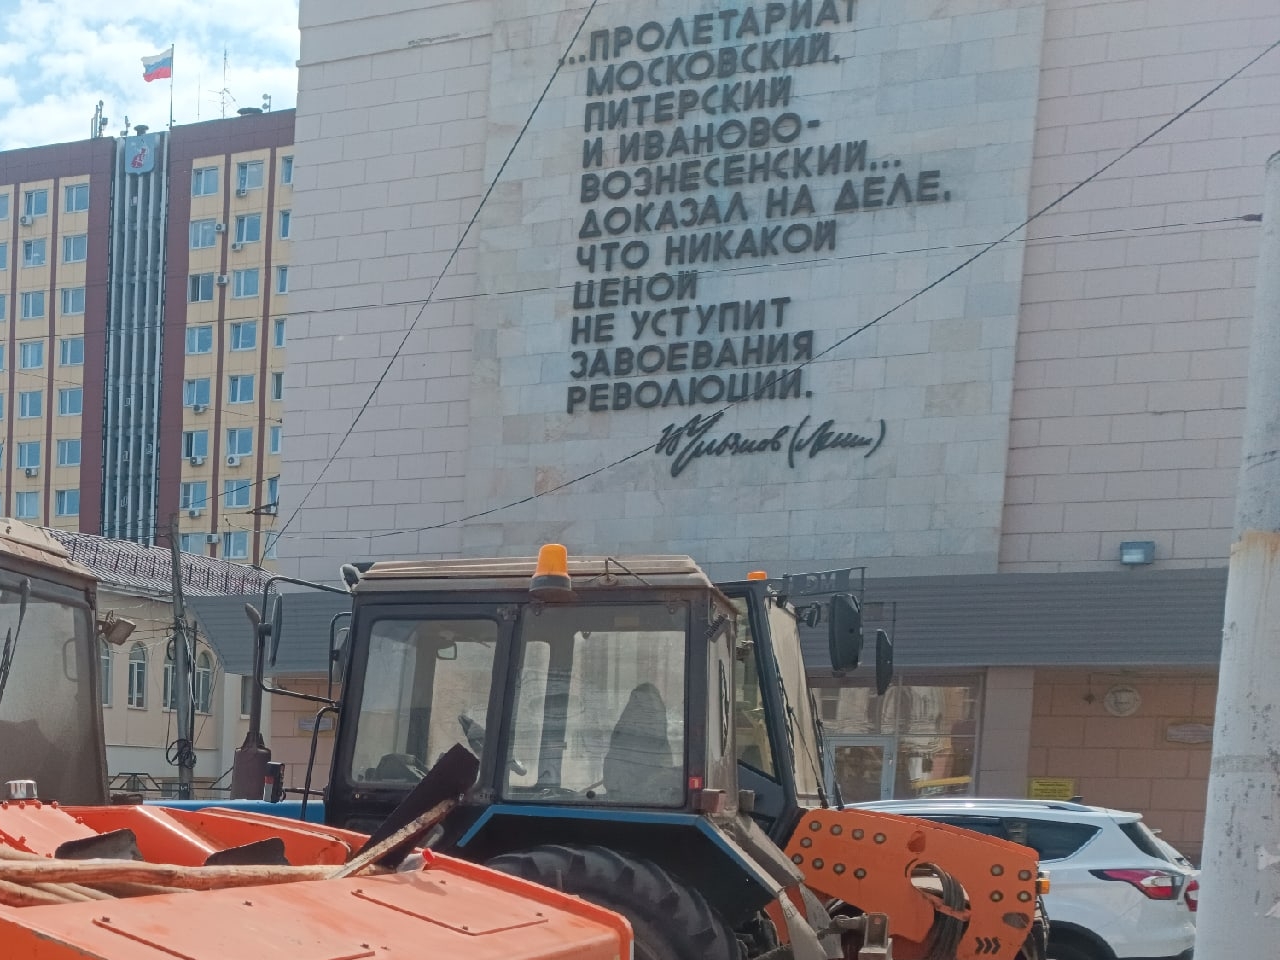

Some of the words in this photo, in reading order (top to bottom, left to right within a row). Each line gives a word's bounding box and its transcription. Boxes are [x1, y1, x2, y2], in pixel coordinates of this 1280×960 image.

[584, 75, 792, 132] ПИТЕРСКИЙ
[582, 136, 604, 169] И
[619, 112, 821, 164] ИВАНОВО-
[578, 191, 749, 240] ДОКАЗАЛ
[766, 184, 816, 214] НА
[576, 240, 650, 274] ЧТО
[664, 220, 837, 266] НИКАКОЙ
[572, 270, 698, 310] ЦЕНОЙ
[571, 312, 616, 345] НЕ
[630, 296, 792, 341] УСТУПИТ
[569, 330, 814, 379] ЗАВОЕВАНИЯ
